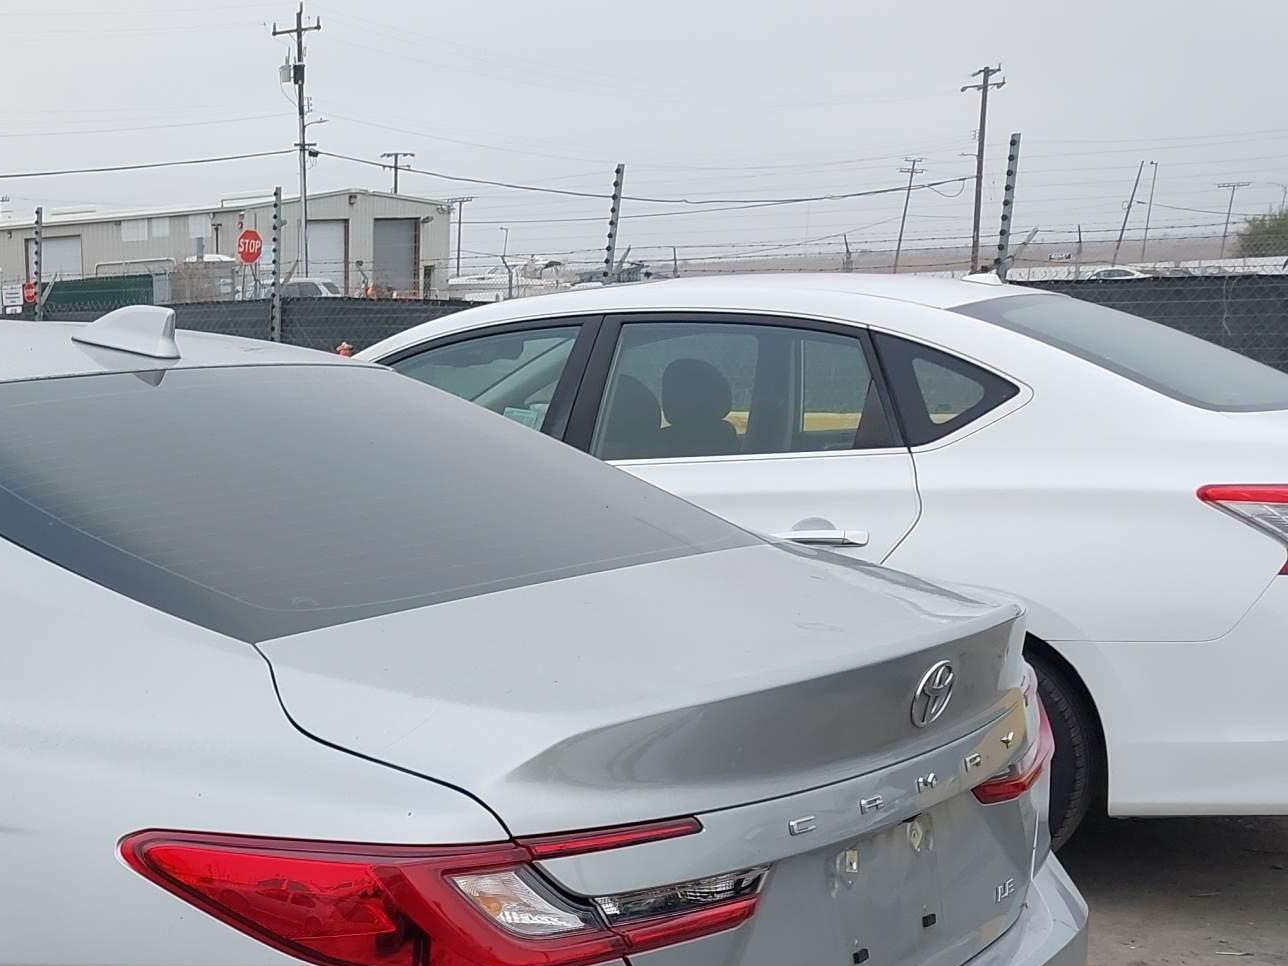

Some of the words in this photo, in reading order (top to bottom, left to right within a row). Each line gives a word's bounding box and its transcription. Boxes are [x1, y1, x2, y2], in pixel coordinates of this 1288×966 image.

[239, 239, 261, 253] STOP
[787, 731, 1015, 836] CAMRY
[995, 878, 1016, 904] LE
